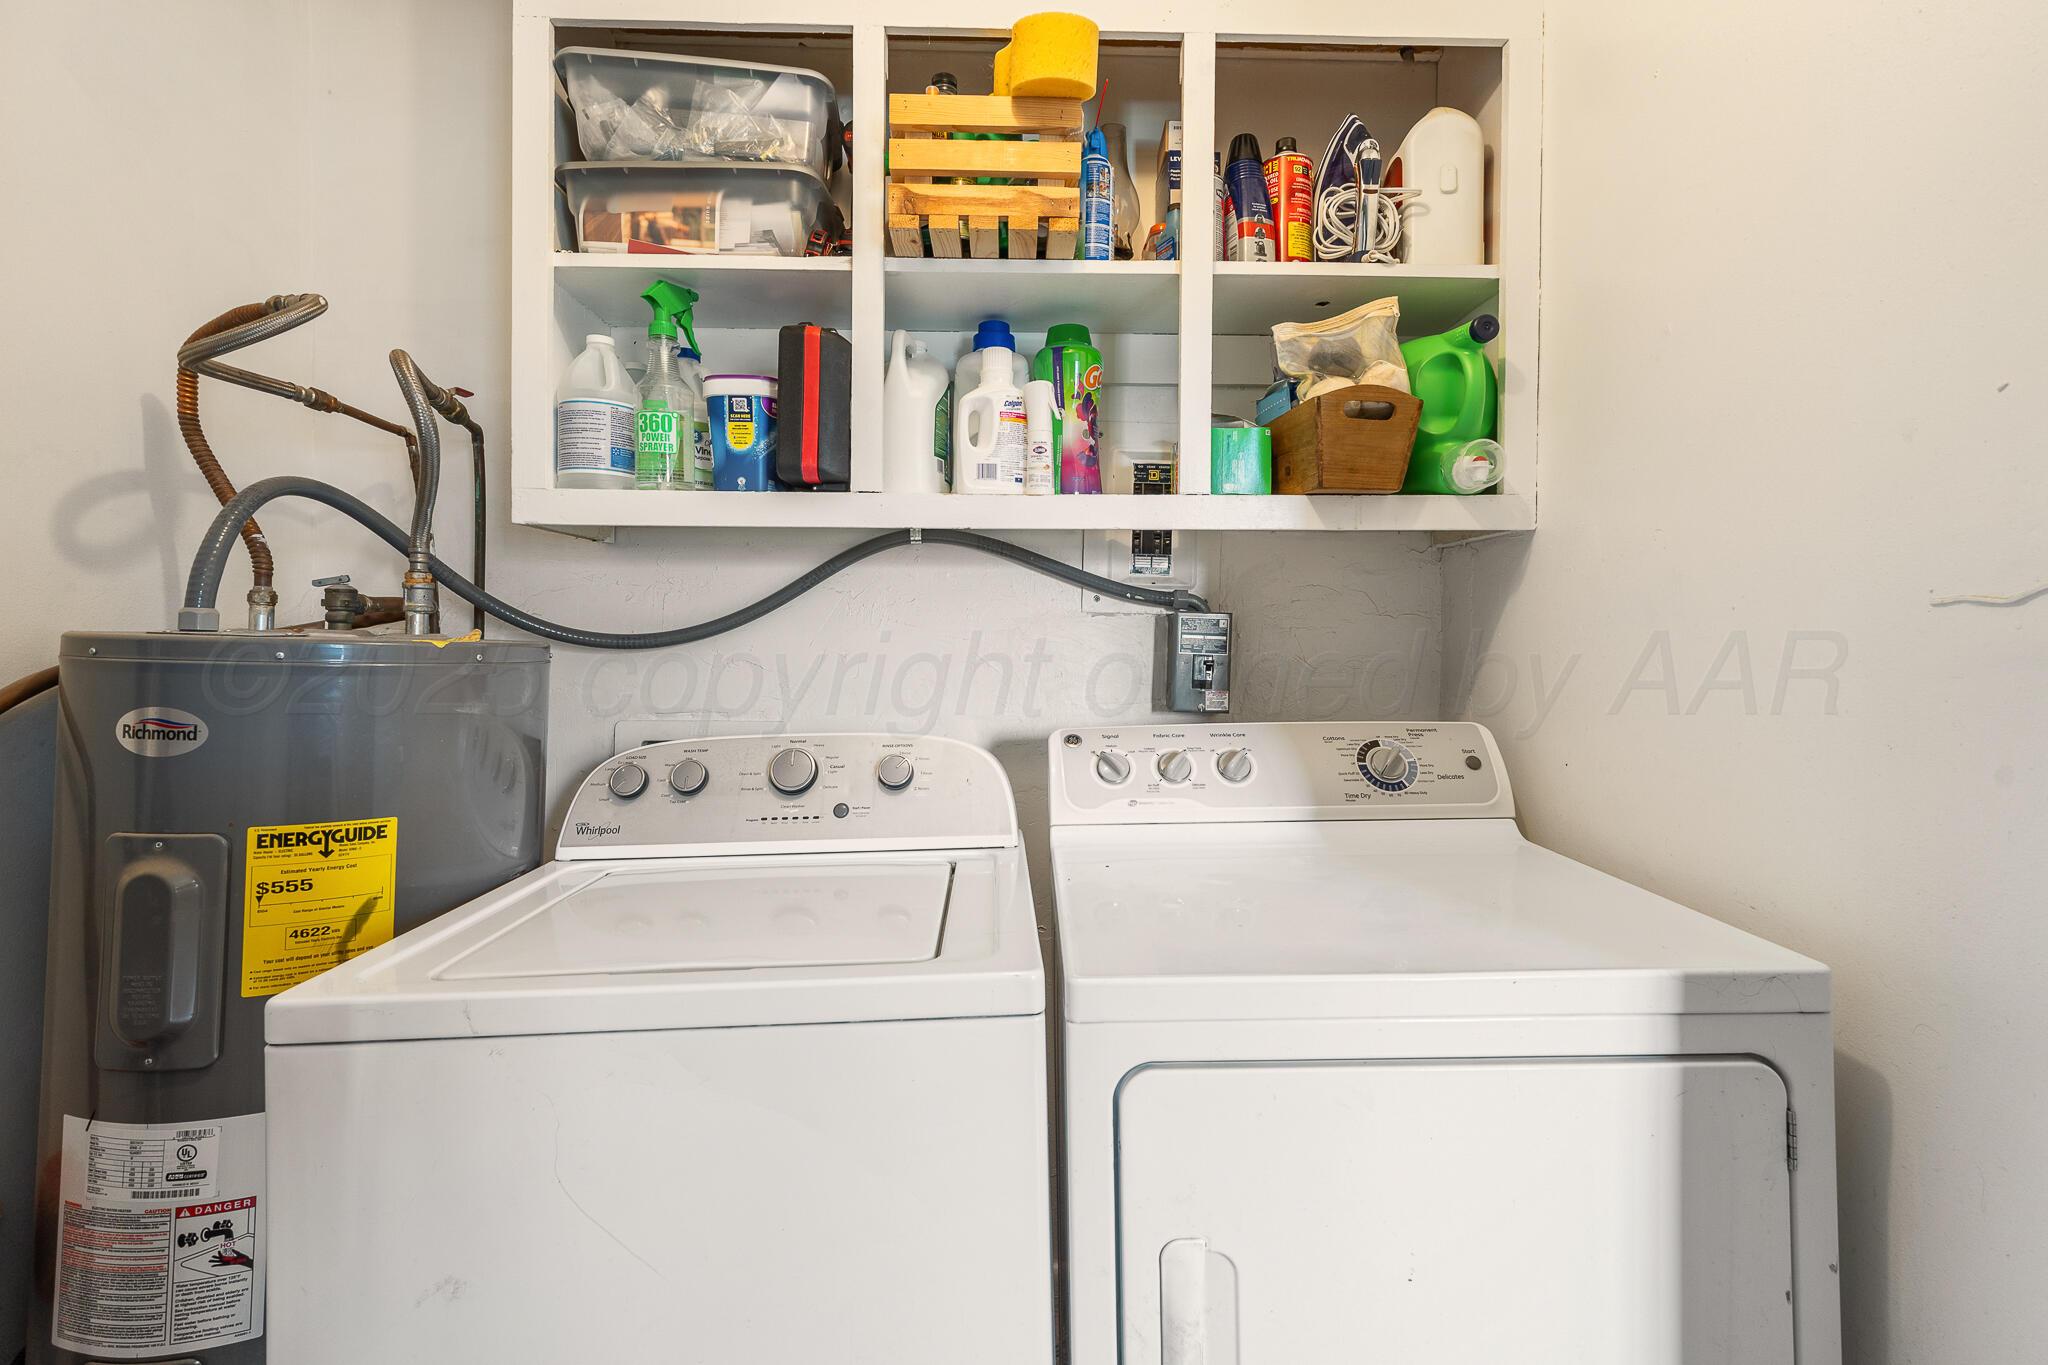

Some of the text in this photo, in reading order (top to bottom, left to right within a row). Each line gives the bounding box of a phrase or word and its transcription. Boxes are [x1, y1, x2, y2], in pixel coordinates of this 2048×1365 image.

[642, 432, 670, 442] POWER
[640, 442, 674, 452] SPRAYER
[122, 723, 198, 743] Richmond
[576, 825, 620, 837] Whirlpool
[256, 824, 388, 854] ENERGYGUIDE
[280, 866, 307, 875] Estimated
[326, 864, 345, 872] Energy
[256, 878, 314, 896] $555
[288, 926, 331, 940] 4622
[182, 1148, 192, 1158] UL
[194, 1199, 251, 1215] DANGER
